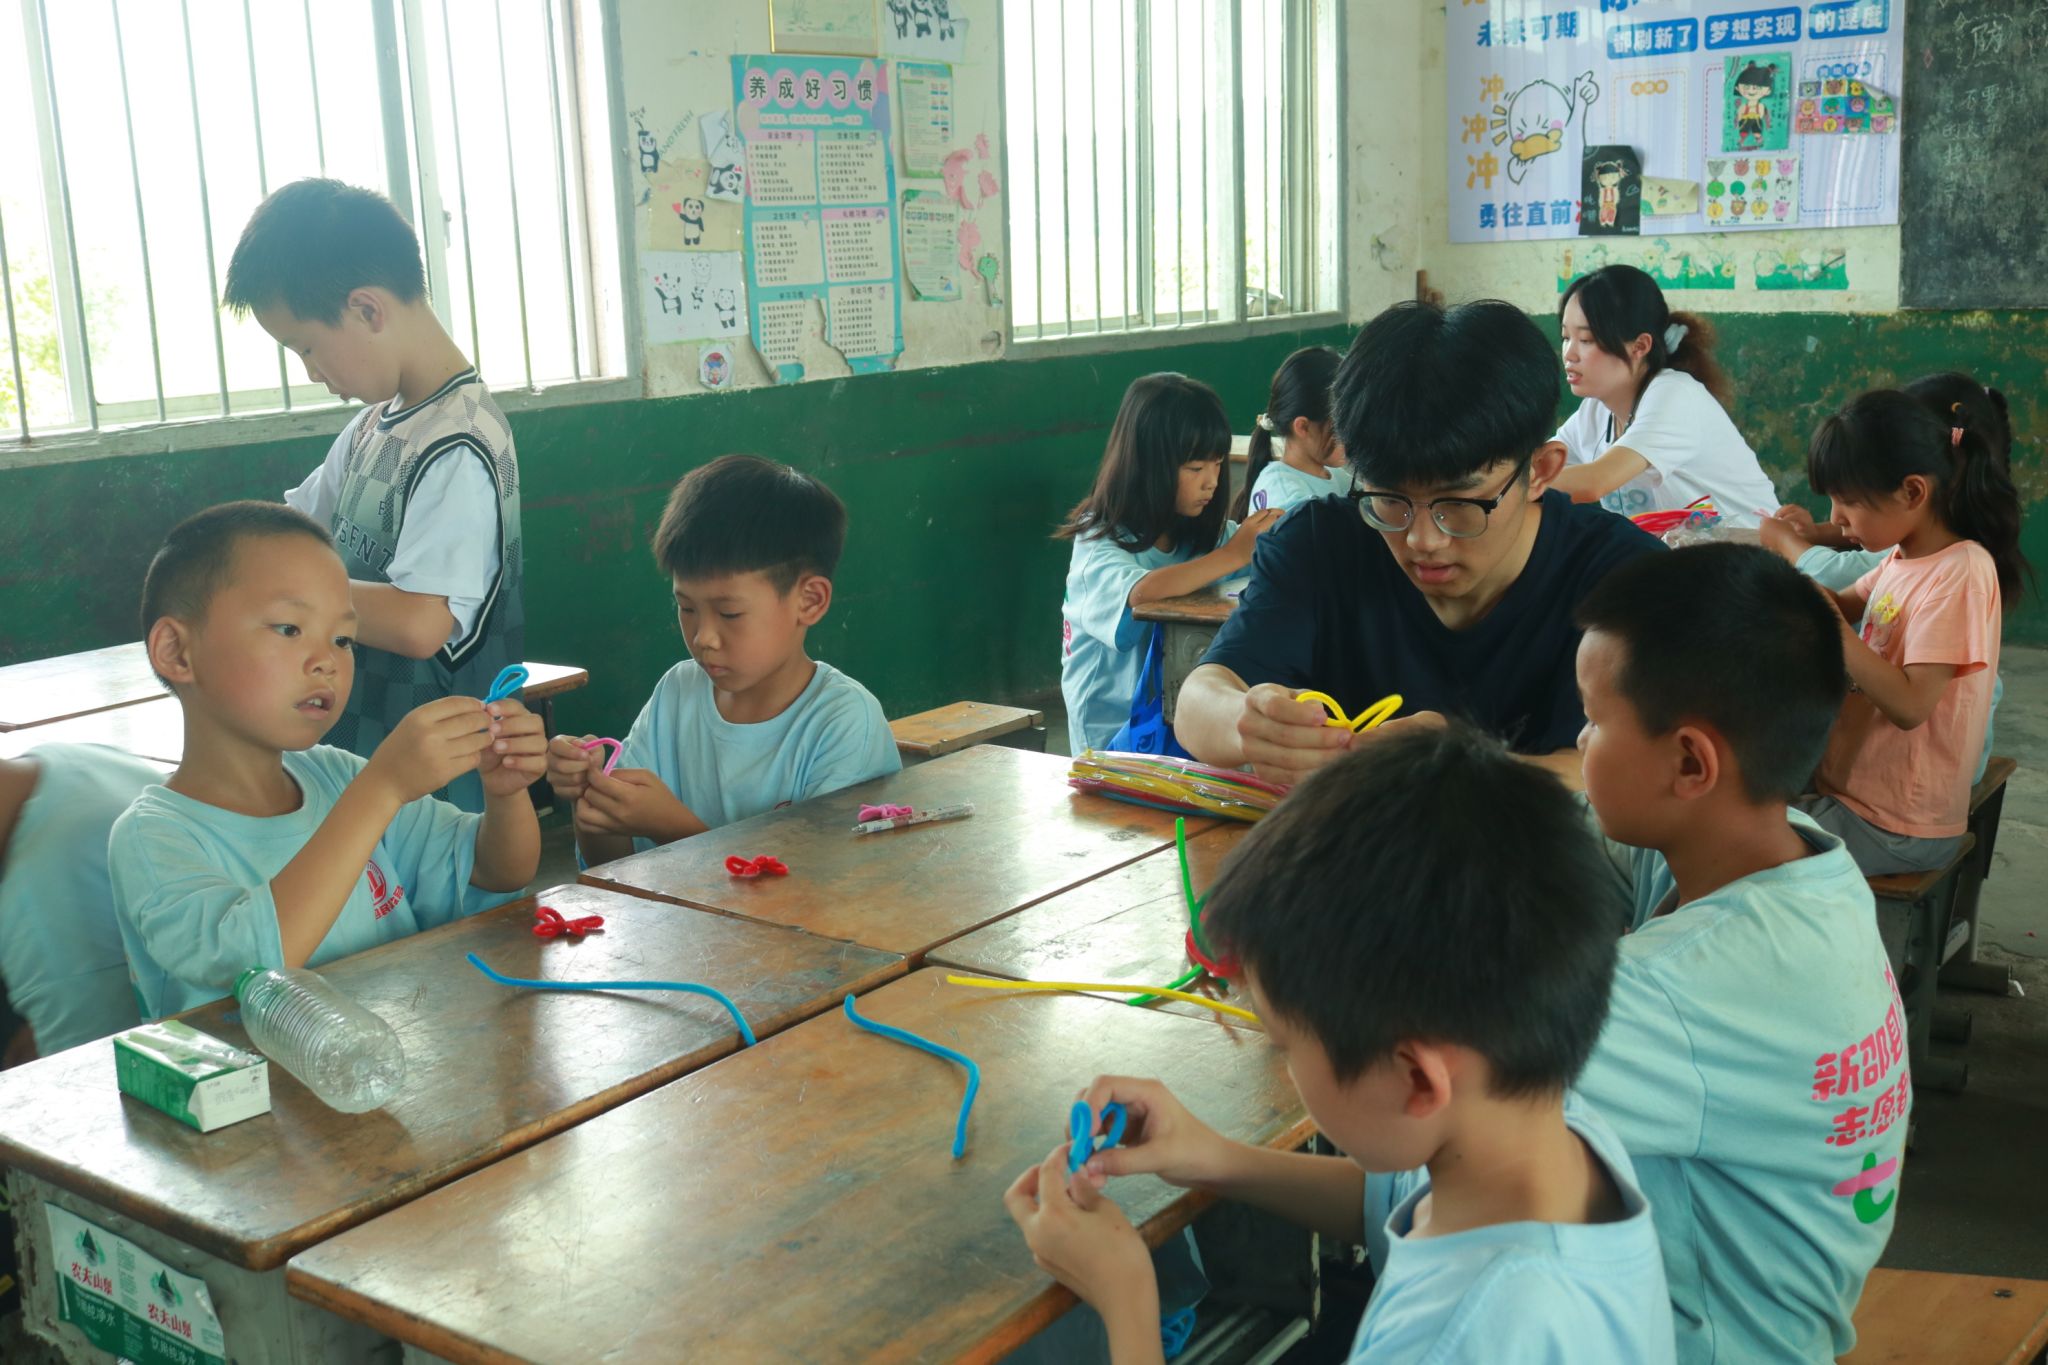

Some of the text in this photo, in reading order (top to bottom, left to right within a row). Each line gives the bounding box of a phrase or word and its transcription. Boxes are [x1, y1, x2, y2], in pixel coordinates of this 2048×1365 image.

[1477, 11, 1578, 47] 未来可期
[1613, 4, 1883, 53] 都刷新了 梦想实现 的速度
[749, 76, 873, 101] 养成好习惯
[1479, 73, 1505, 103] 冲
[1461, 112, 1489, 144] 冲
[1466, 150, 1499, 190] 冲
[1479, 199, 1581, 229] 勇往直前
[71, 1261, 113, 1297] 农夫山泉
[147, 1303, 193, 1341] 农夫山泉
